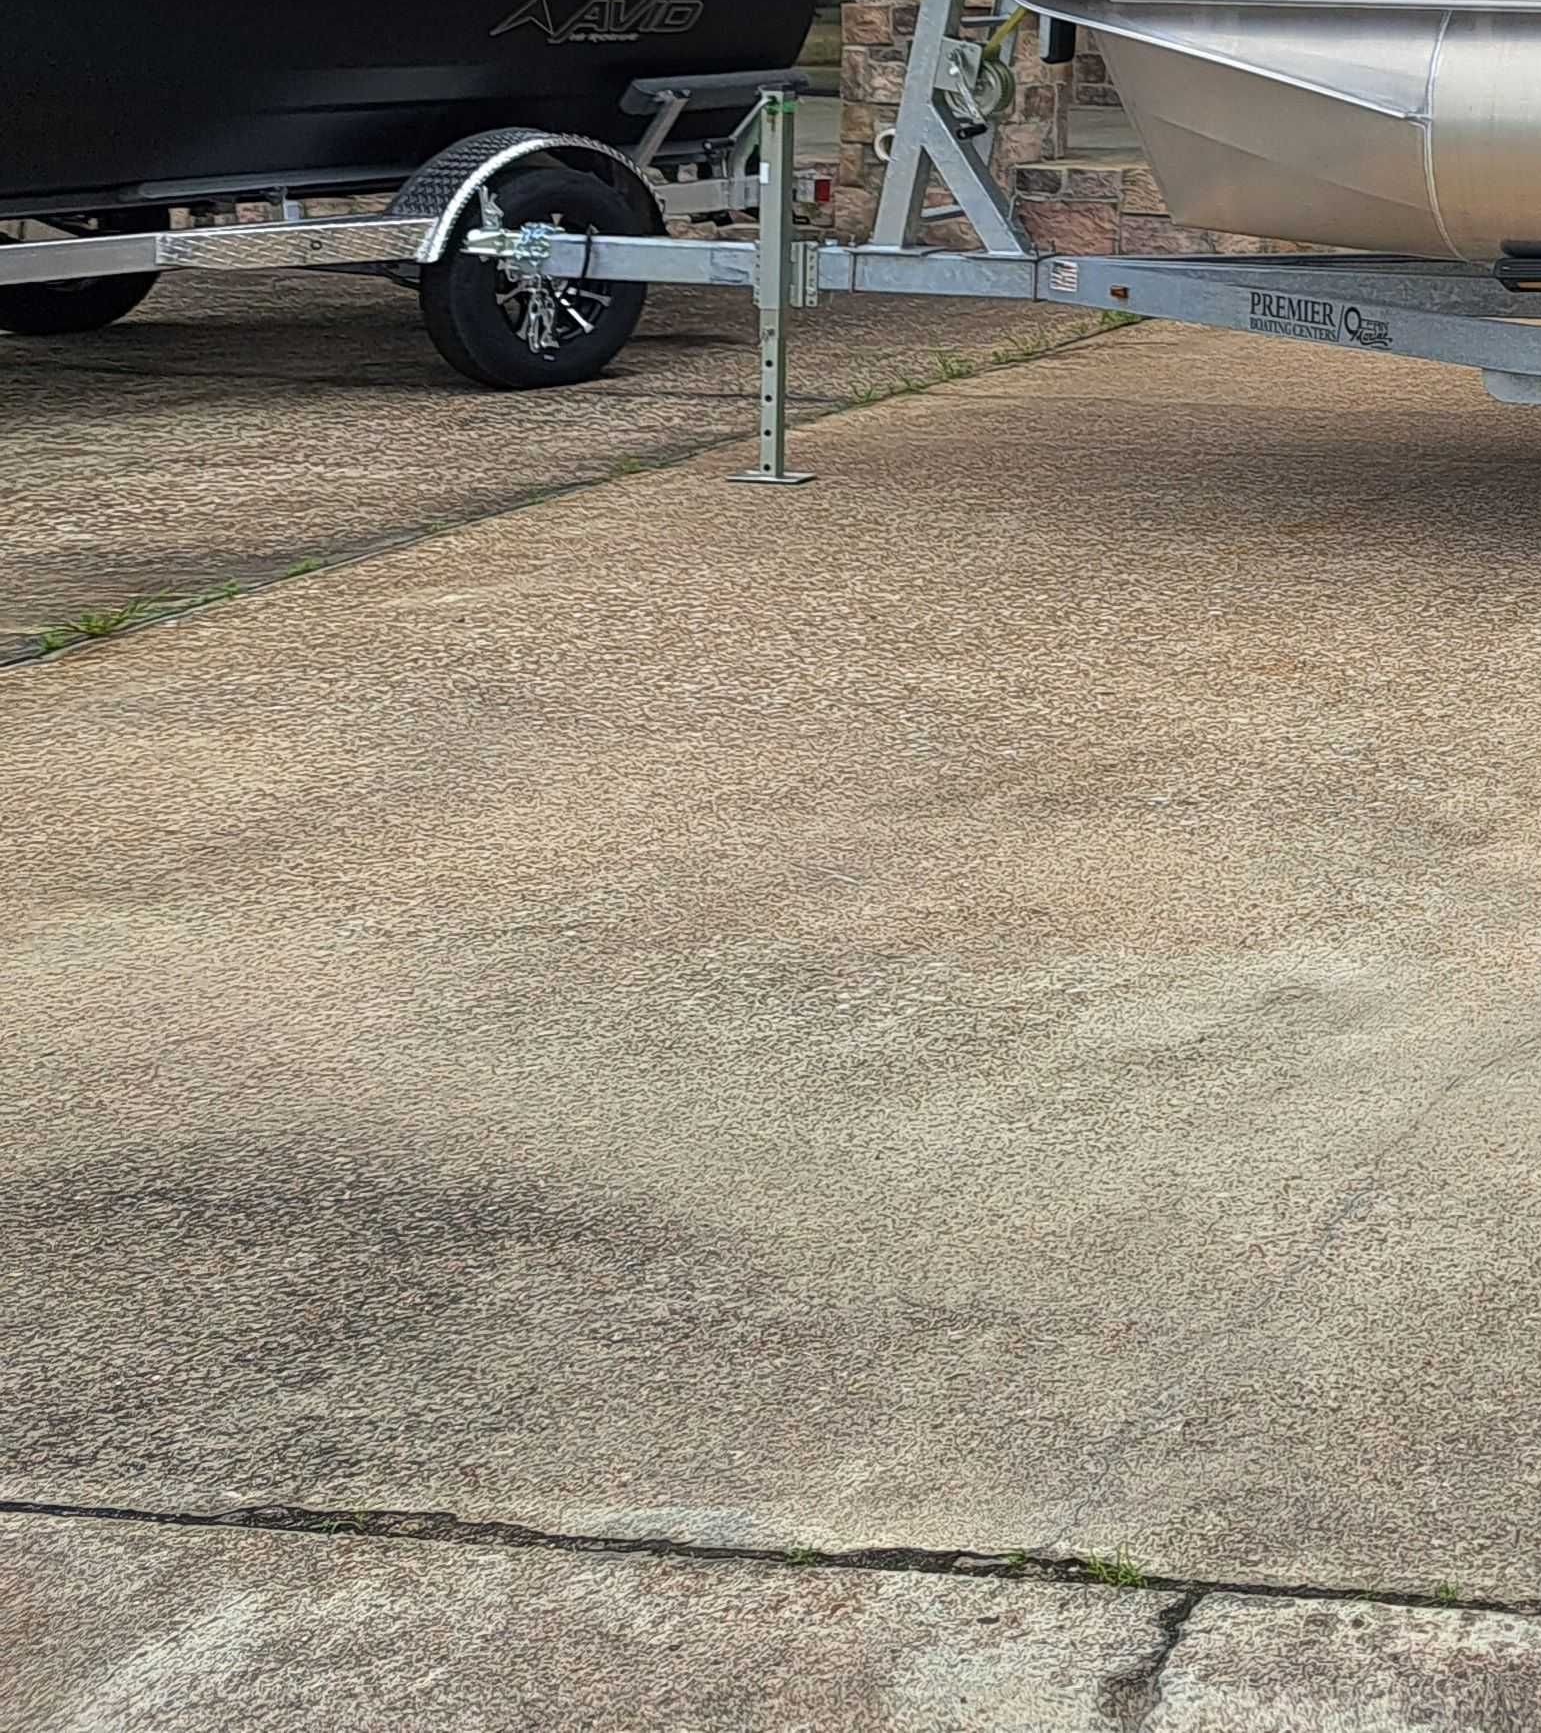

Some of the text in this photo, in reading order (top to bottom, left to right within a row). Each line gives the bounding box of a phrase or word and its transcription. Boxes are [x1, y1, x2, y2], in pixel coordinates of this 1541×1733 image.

[1249, 290, 1337, 328] PREMIER
[1249, 316, 1339, 343] BOATING CENTERS
